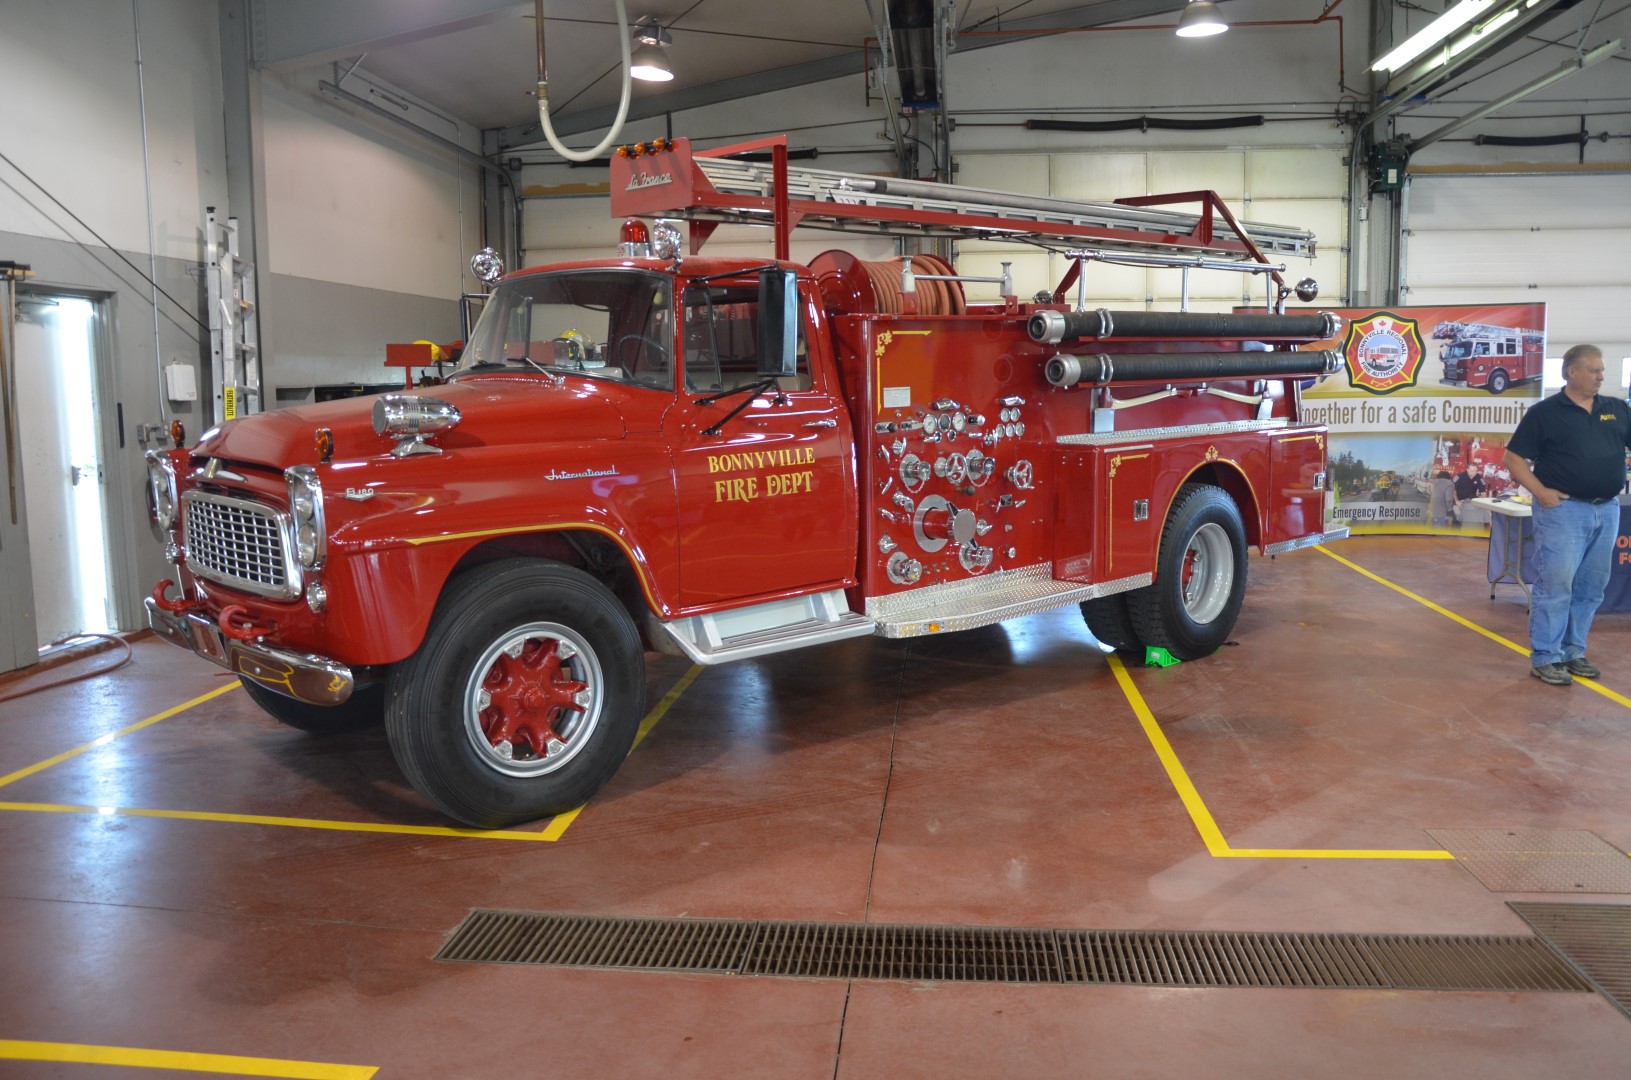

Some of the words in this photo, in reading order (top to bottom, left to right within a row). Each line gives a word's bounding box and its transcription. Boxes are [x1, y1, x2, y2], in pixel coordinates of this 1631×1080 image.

[640, 172, 672, 187] France
[1358, 329, 1385, 358] BONNYVILLE
[1386, 329, 1407, 356] REGIONAL
[1361, 361, 1371, 374] FIRE
[1371, 362, 1403, 377] AUTHORITY
[226, 390, 234, 417] FEATHERLITE
[1301, 402, 1357, 424] ogether
[1360, 400, 1383, 424] for
[1387, 405, 1397, 424] a
[1402, 400, 1437, 424] safe
[1442, 399, 1528, 425] Communit
[707, 447, 816, 473] BONNYVILLE
[544, 464, 620, 481] International
[714, 477, 759, 503] FIRE
[766, 471, 813, 496] DEPT
[1333, 506, 1377, 520] Emergency
[1379, 505, 1421, 520] Response
[1616, 535, 1631, 548] O
